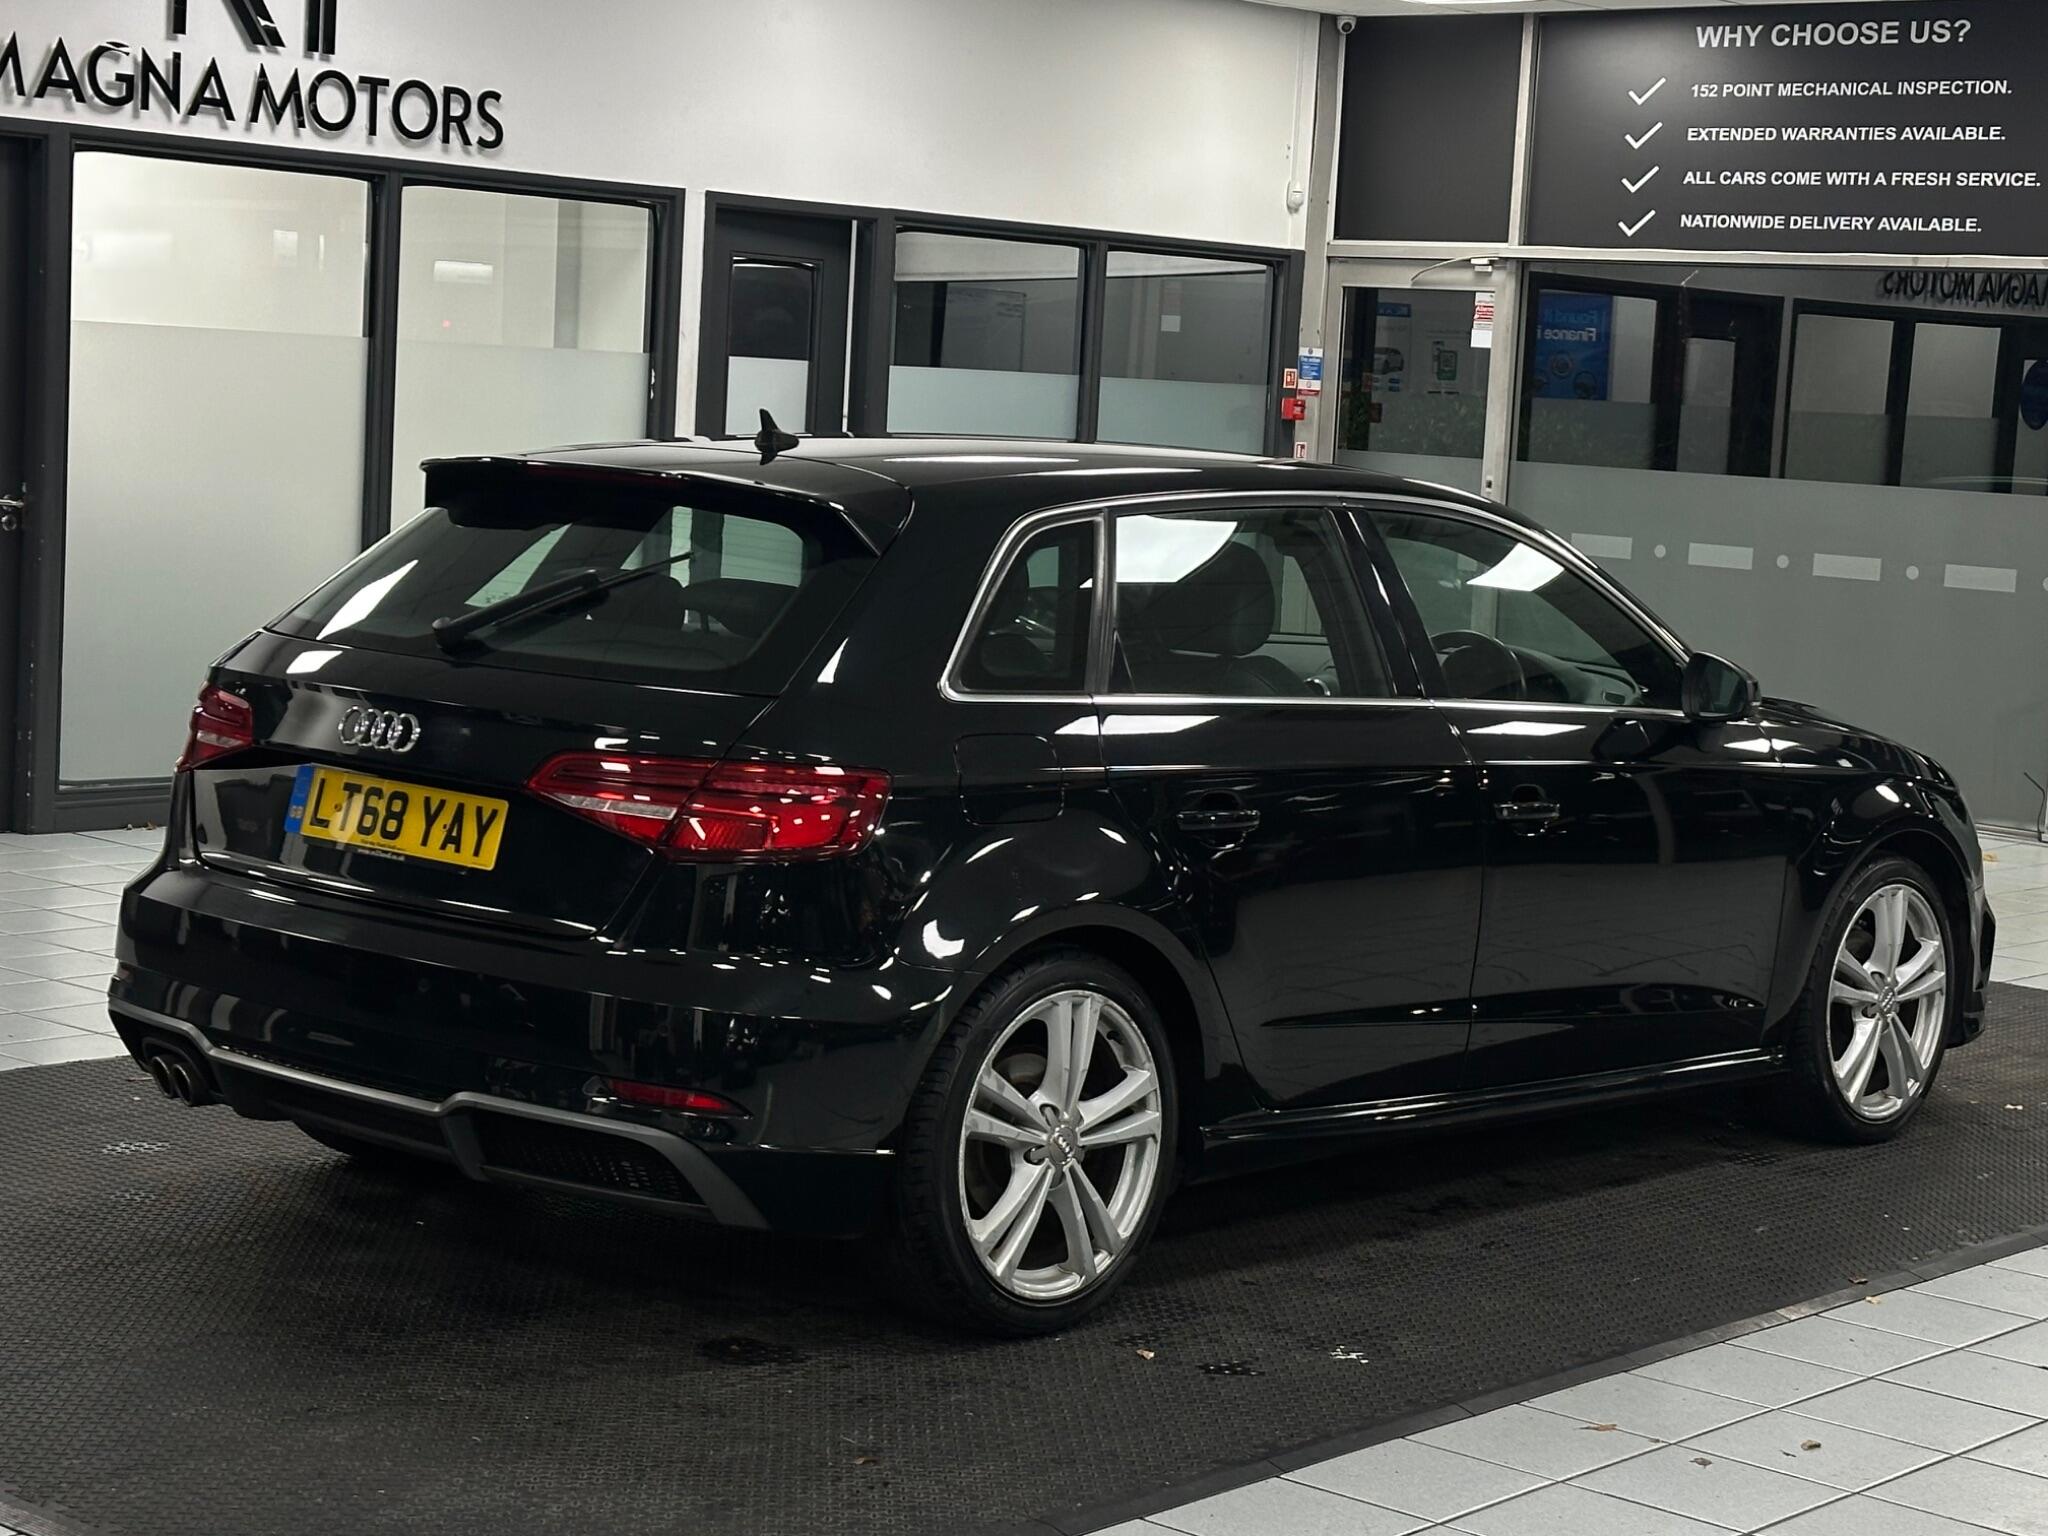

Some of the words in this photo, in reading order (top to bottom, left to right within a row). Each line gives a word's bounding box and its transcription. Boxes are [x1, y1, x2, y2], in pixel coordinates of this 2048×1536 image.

[1696, 24, 1764, 48] WHY
[1770, 21, 1900, 47] CHOOSE
[1910, 19, 1972, 44] US?
[1691, 84, 1718, 97] 152
[1722, 83, 1774, 97] POINT
[1777, 82, 1894, 97] MECHANICAL
[1897, 79, 2013, 96] INSPECTION.
[250, 63, 504, 150] MOTORS
[1687, 127, 1777, 141] EXTENDED
[1781, 127, 1897, 141] WARRANTIES
[1900, 126, 2006, 141] AVAILABLE.
[1682, 171, 1716, 185] ALL
[1719, 171, 1767, 185] CARS
[1770, 171, 1822, 185] COME
[1826, 171, 1870, 186] WITH
[1873, 172, 1887, 186] A
[1891, 172, 1951, 187] FRESH
[1955, 172, 2041, 187] SERVICE.
[1680, 214, 1786, 229] NATIONWIDE
[1789, 215, 1875, 231] DELIVERY
[1877, 217, 1982, 232] AVAILABLE.
[309, 778, 410, 841] LT68
[420, 796, 499, 858] YAY
